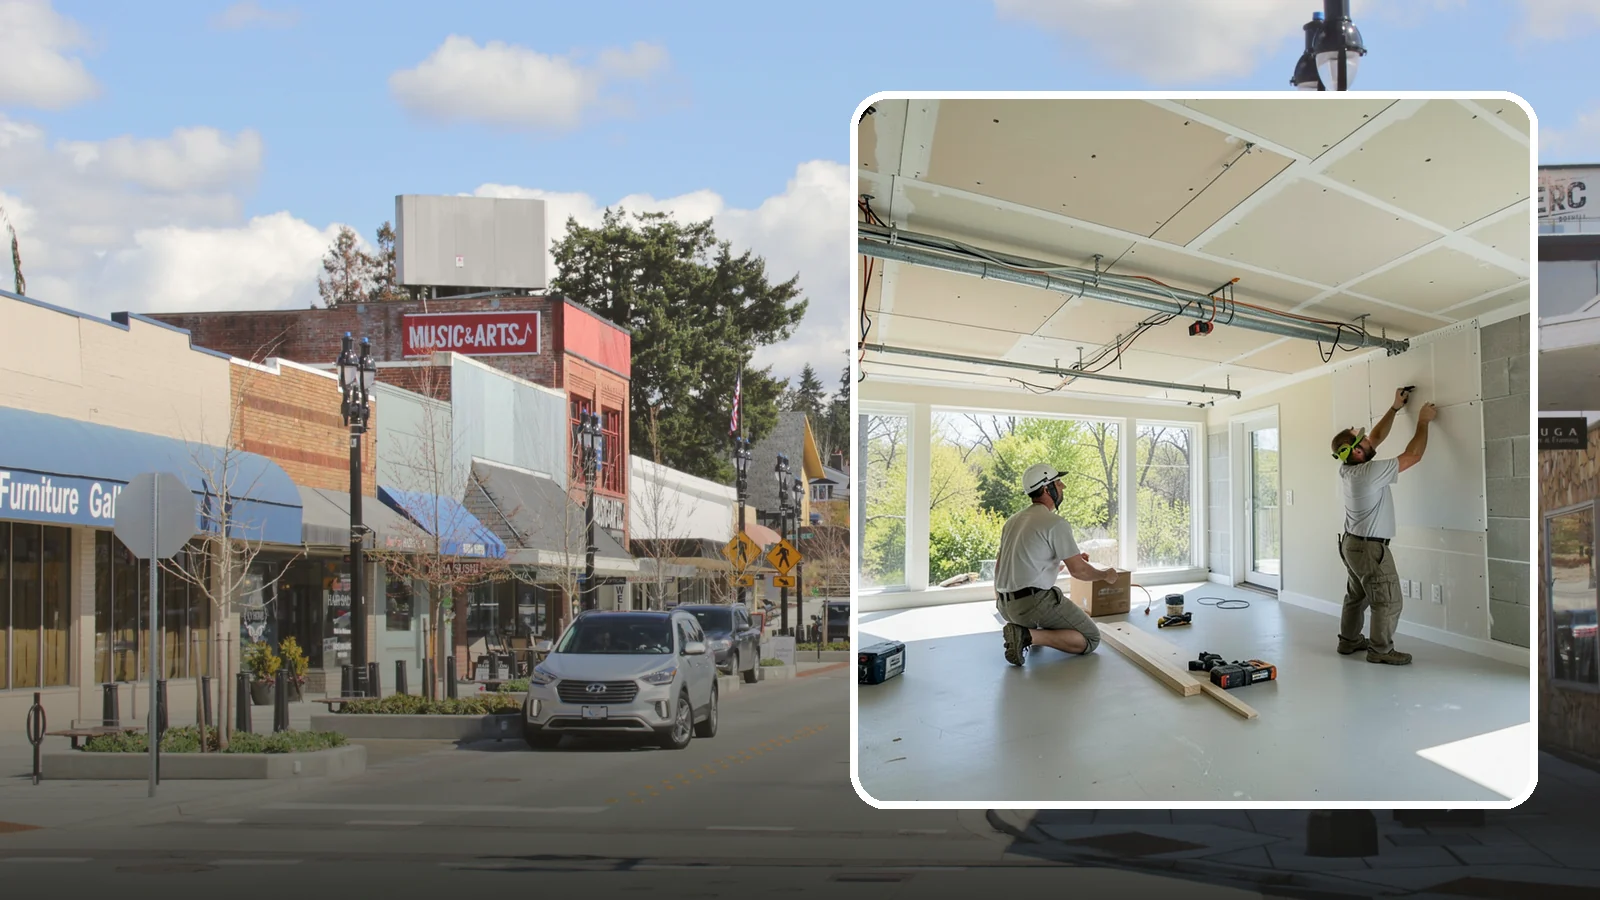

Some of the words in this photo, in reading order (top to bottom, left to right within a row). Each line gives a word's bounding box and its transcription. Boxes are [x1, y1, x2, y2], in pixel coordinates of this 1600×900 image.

[0, 471, 79, 515] Furniture
[89, 482, 122, 519] Gal
[453, 563, 479, 574] SUSHI
